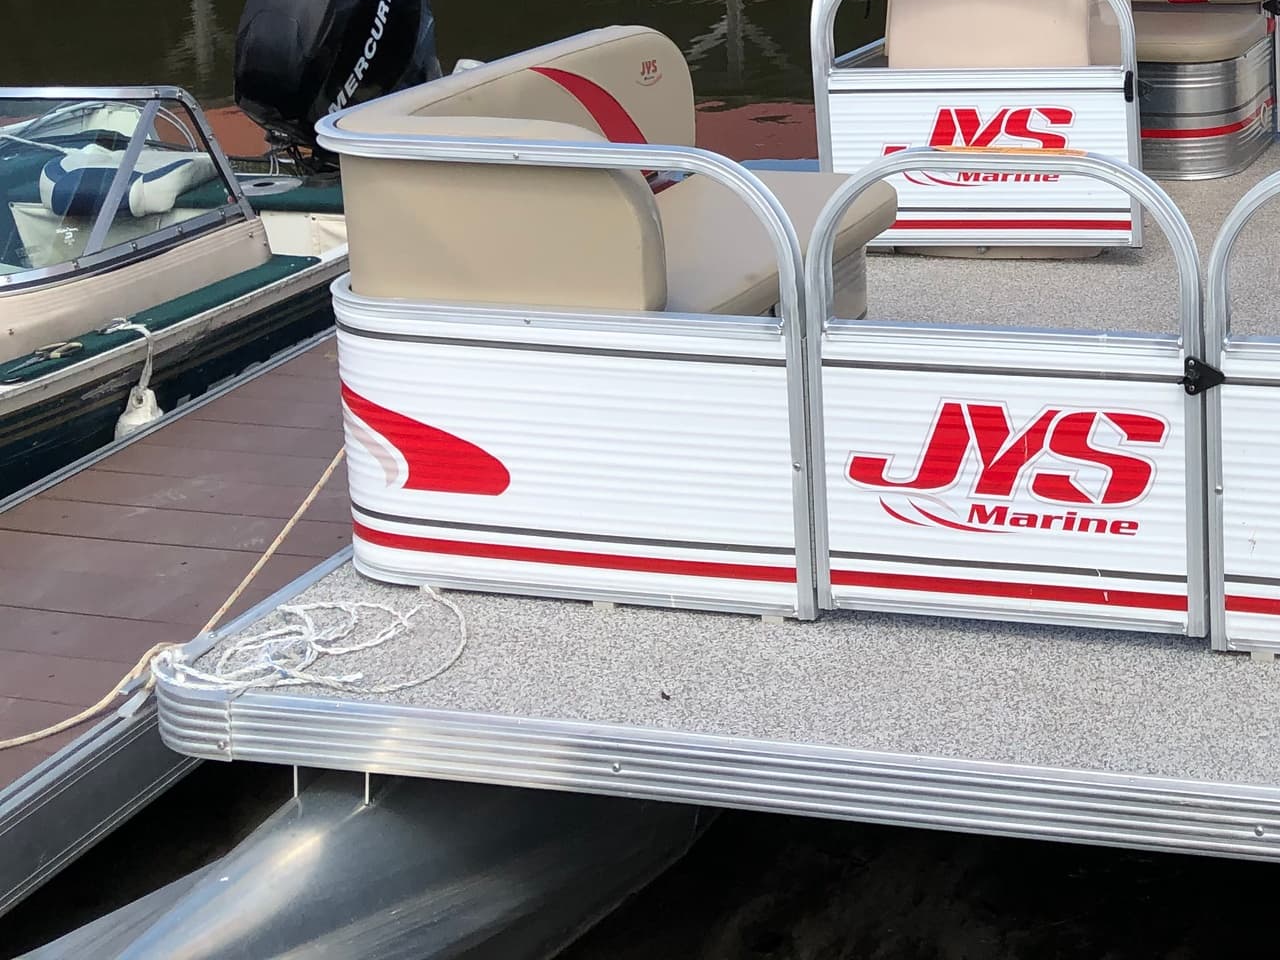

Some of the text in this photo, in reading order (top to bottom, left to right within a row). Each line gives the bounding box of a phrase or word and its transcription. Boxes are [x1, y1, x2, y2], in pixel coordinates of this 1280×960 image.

[640, 59, 657, 76] JYS
[846, 400, 1168, 506] JYS
[966, 503, 1140, 537] Marine
